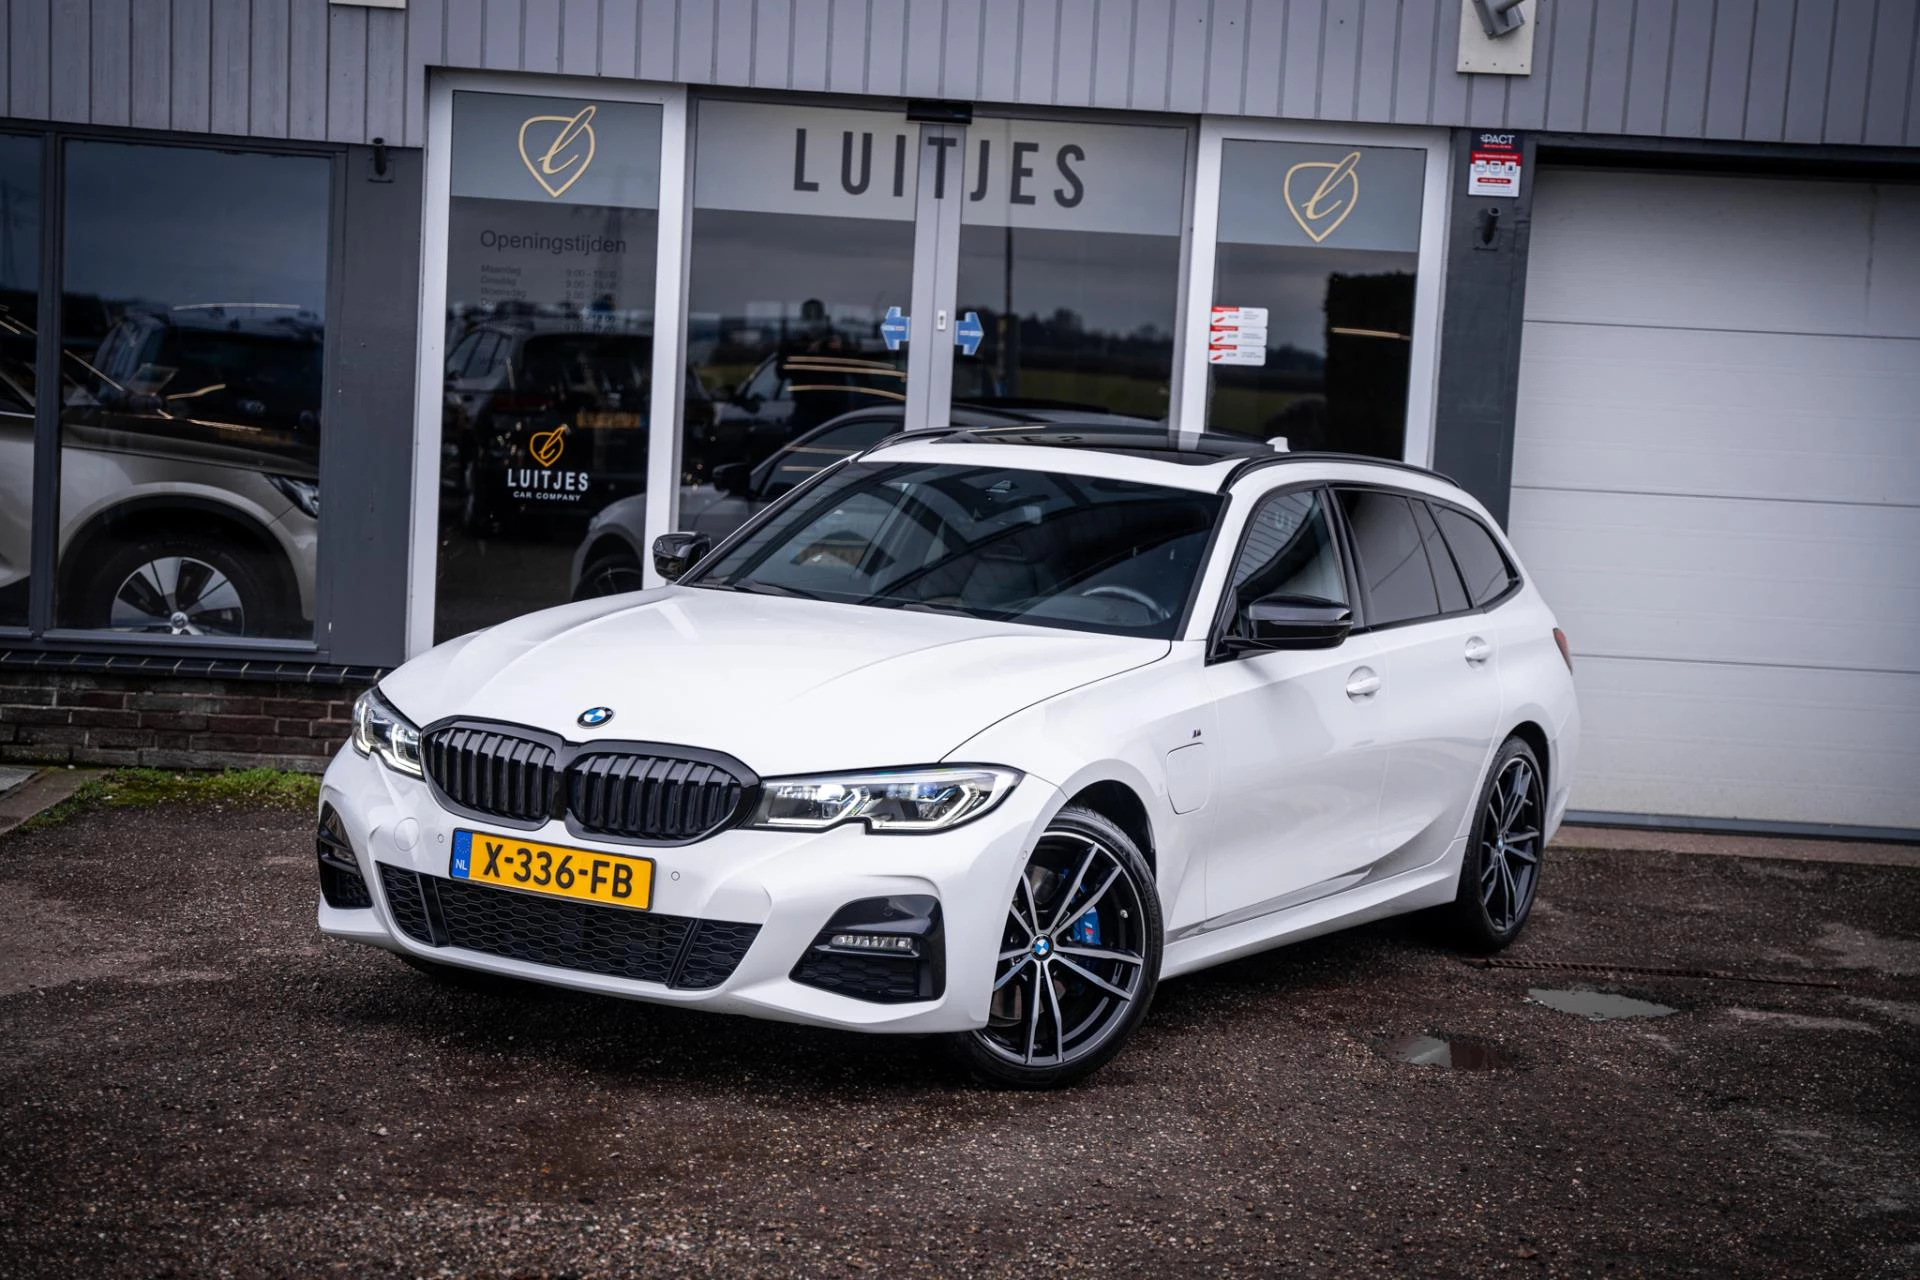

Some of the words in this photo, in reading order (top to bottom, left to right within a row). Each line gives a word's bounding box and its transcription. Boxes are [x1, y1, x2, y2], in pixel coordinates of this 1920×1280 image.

[794, 128, 1085, 208] LUITJES
[480, 230, 626, 256] Openingstijden
[507, 468, 589, 491] LUITJES
[513, 490, 532, 498] CAR
[535, 492, 581, 501] COMPANY
[455, 858, 468, 871] NL
[482, 841, 634, 899] X-336-FB
